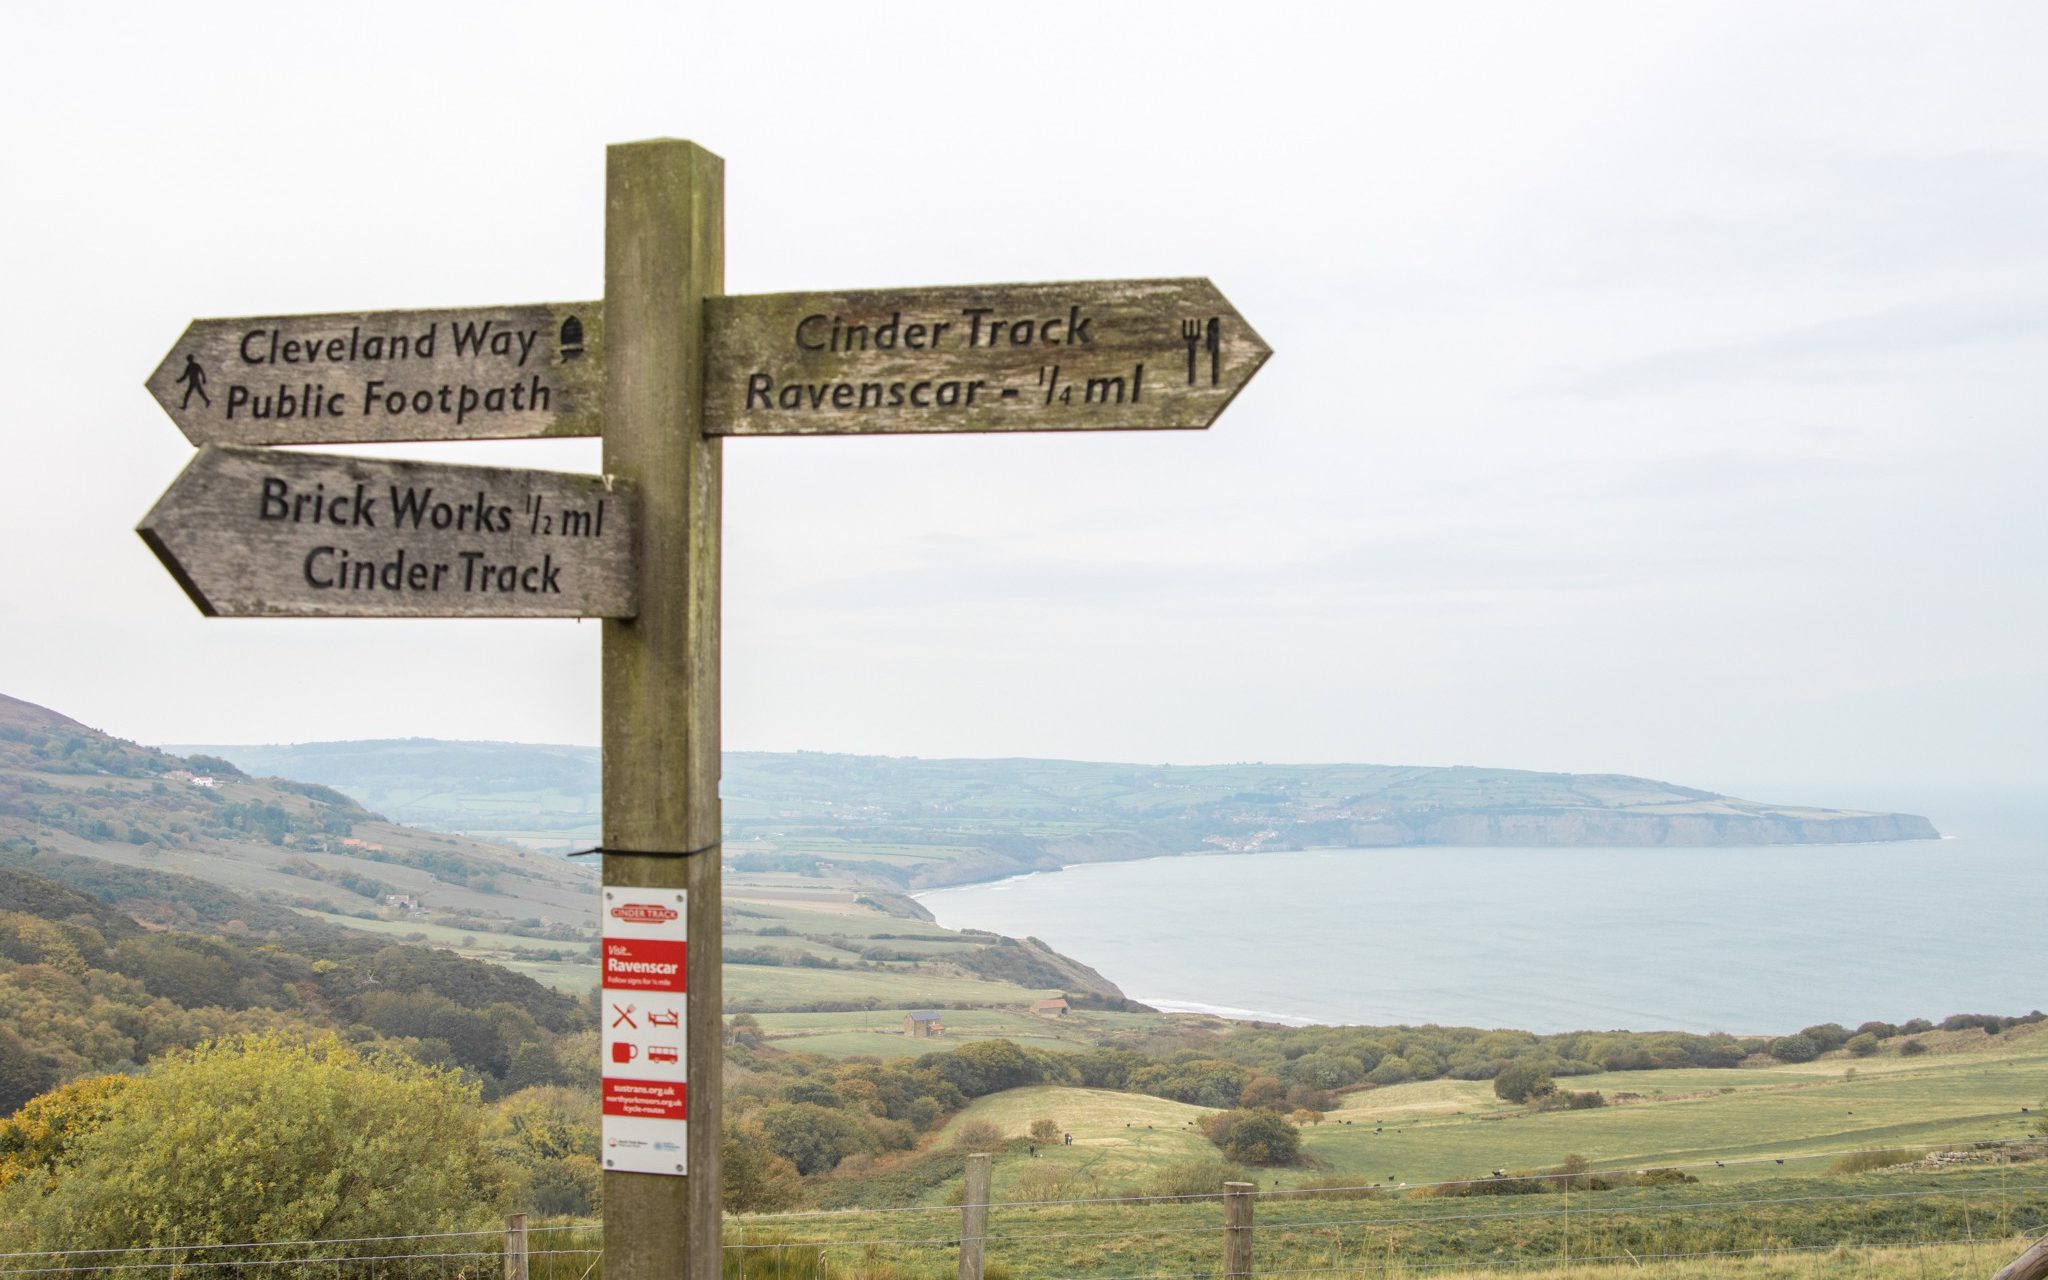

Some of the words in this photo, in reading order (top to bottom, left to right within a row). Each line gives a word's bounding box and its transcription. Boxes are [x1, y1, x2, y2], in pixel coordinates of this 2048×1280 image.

[240, 321, 437, 365] Cleveland
[452, 320, 538, 366] Way
[795, 311, 950, 353] Cinder
[962, 306, 1094, 349] Track
[226, 383, 345, 420] Public
[363, 376, 552, 425] Footpath
[746, 372, 985, 411] Ravenscar
[1085, 364, 1145, 405] ml
[259, 477, 376, 528] Brick
[390, 486, 512, 534] Works
[562, 500, 605, 538] ml
[303, 545, 449, 591] Cinder
[459, 552, 561, 594] Track
[613, 909, 645, 918] CINDER
[647, 910, 676, 919] TRACK
[608, 958, 678, 974] Ravenscar
[614, 1085, 675, 1096] sustrans.org.uk
